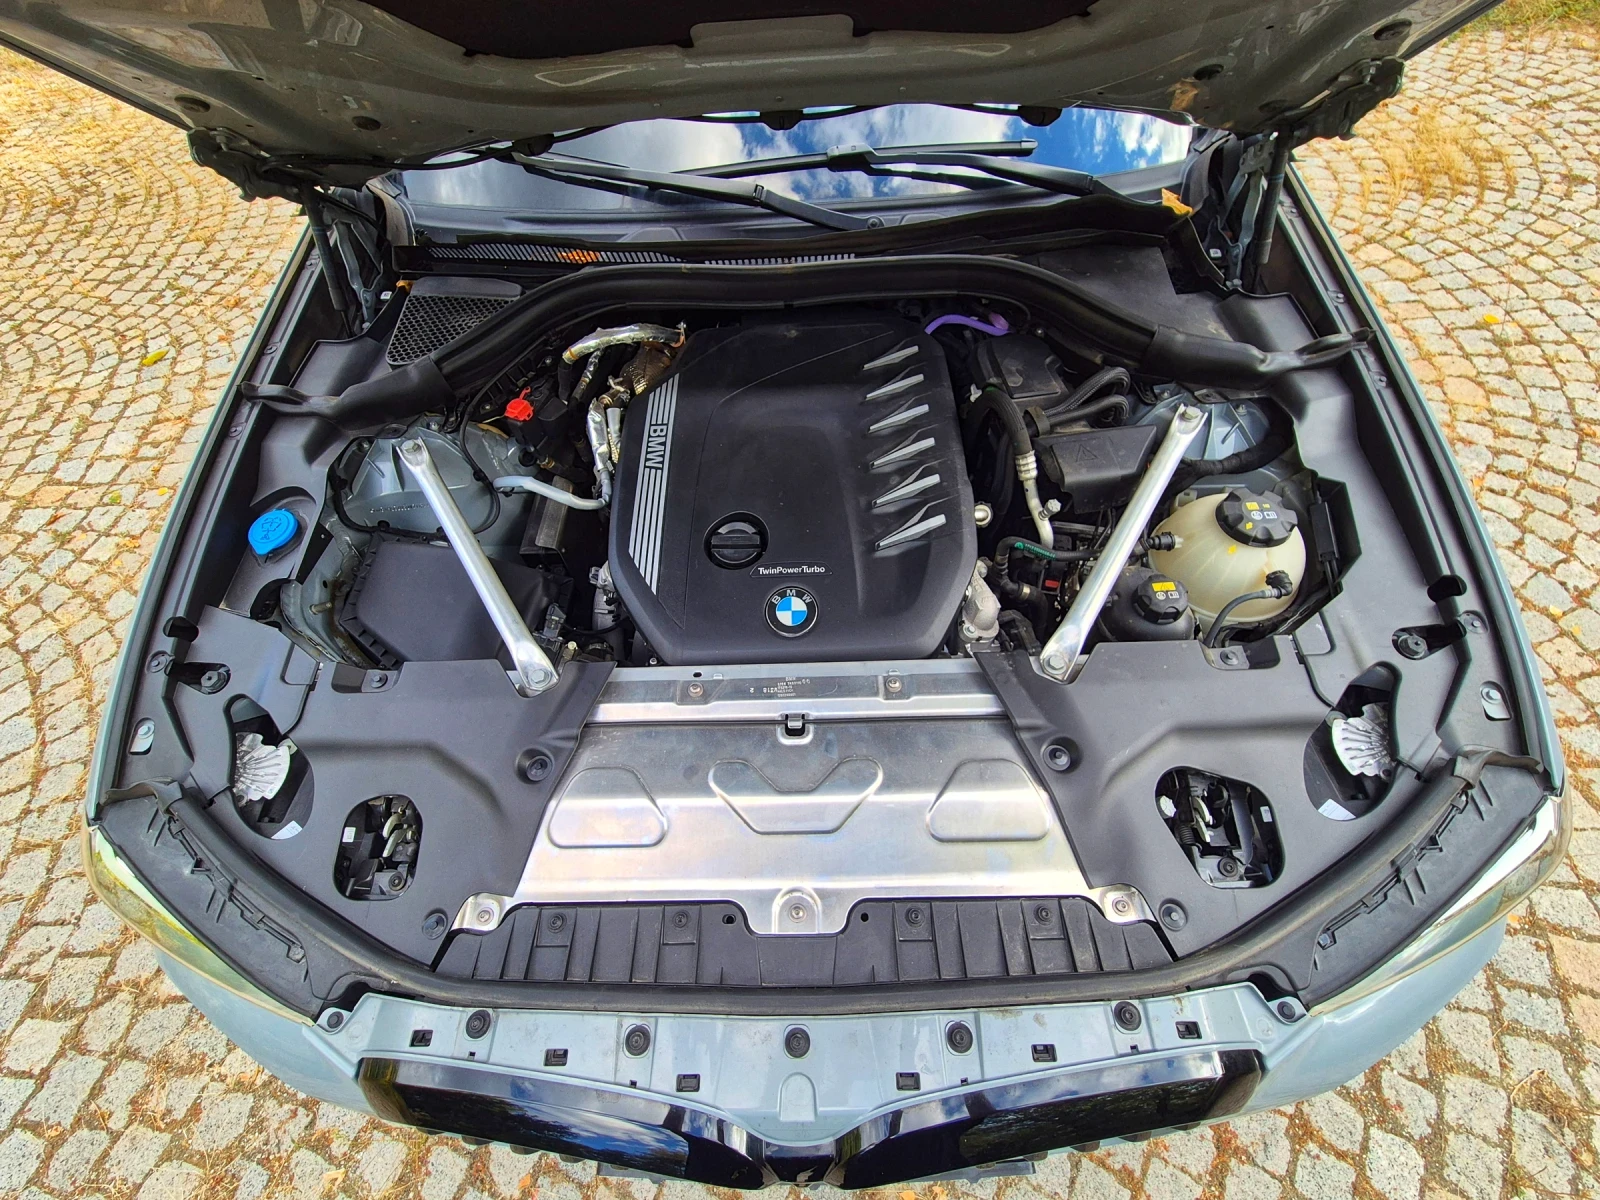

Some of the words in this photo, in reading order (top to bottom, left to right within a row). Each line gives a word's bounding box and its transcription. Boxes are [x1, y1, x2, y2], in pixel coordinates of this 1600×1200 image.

[645, 425, 667, 468] BMW
[757, 565, 826, 575] TwinPowerTurbo
[771, 589, 813, 605] BMW
